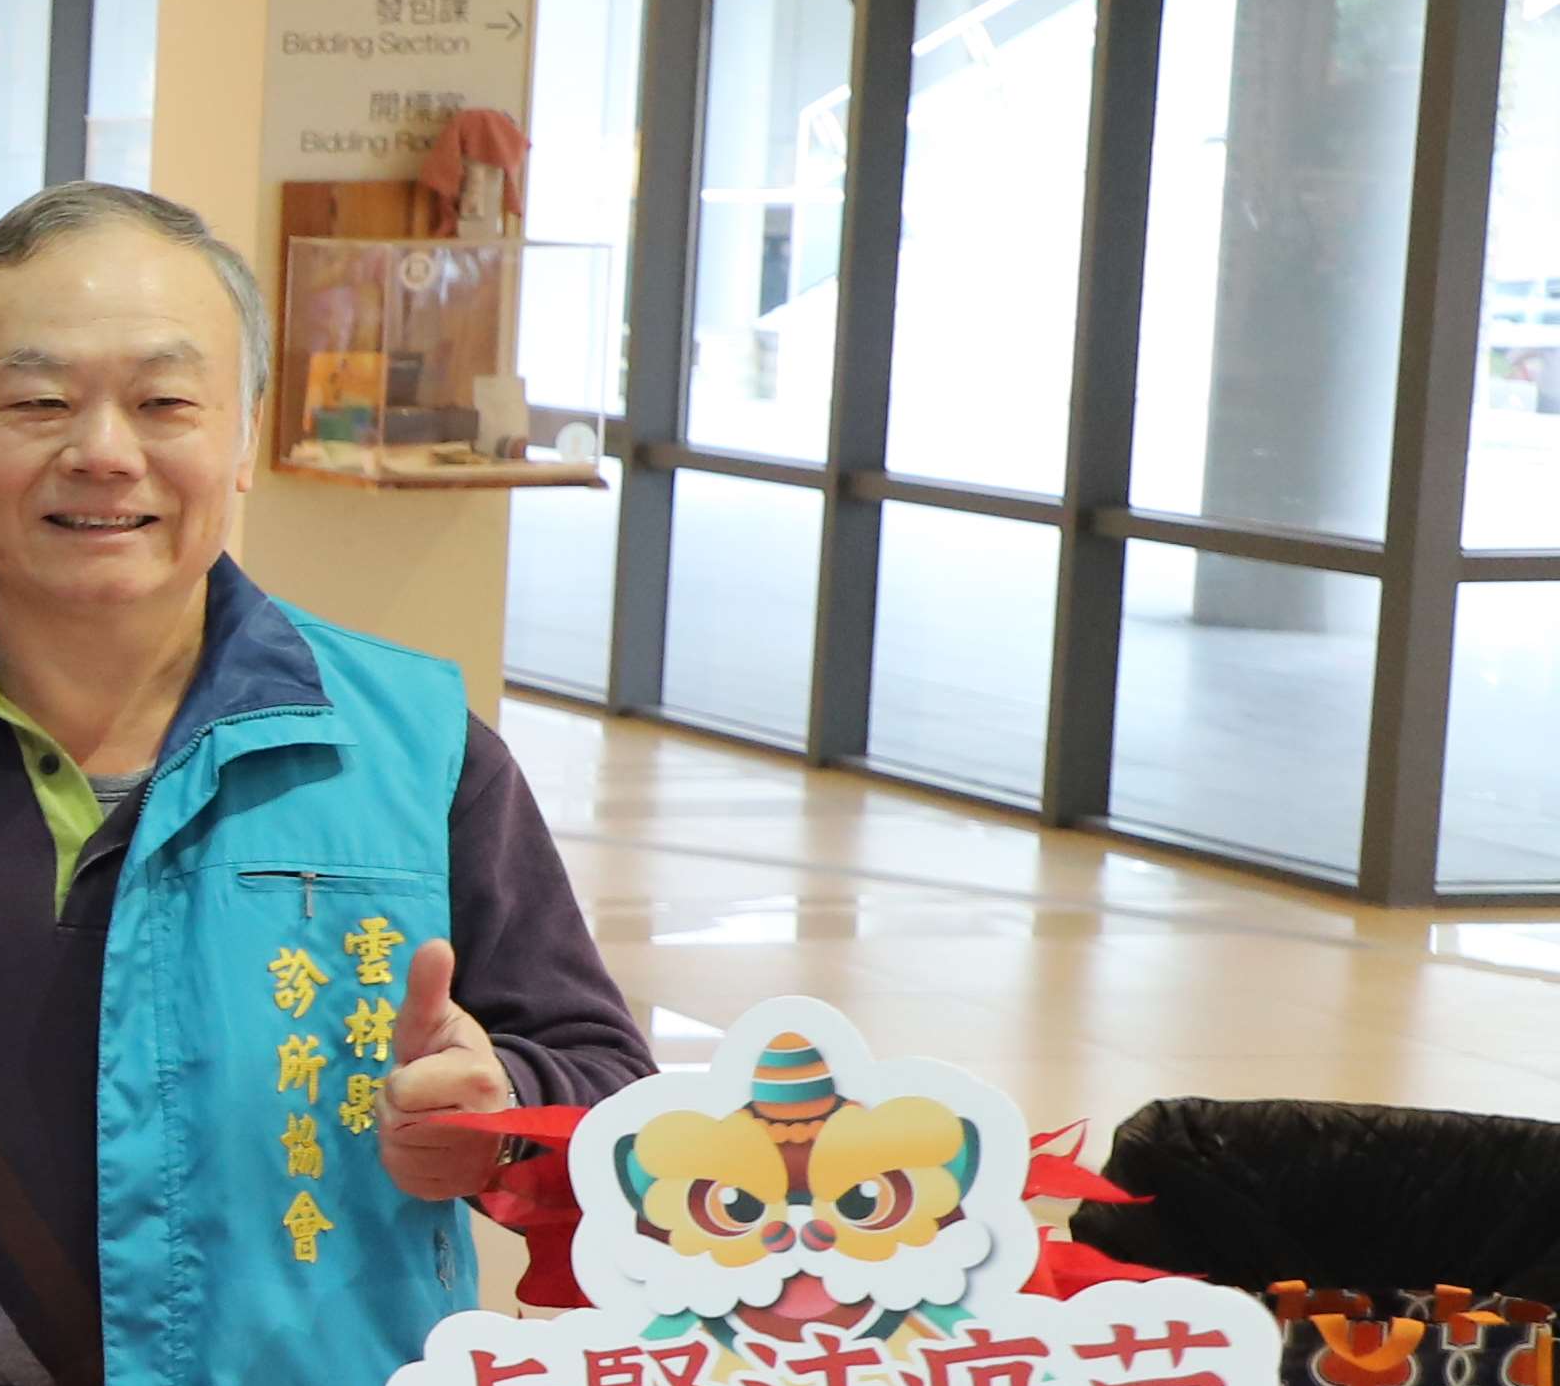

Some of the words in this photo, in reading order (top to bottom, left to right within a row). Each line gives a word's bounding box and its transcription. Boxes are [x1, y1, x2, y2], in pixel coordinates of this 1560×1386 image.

[282, 32, 374, 59] Bidding
[379, 32, 470, 54] Section
[300, 130, 388, 159] Bidding
[267, 948, 335, 1264] 診所協會
